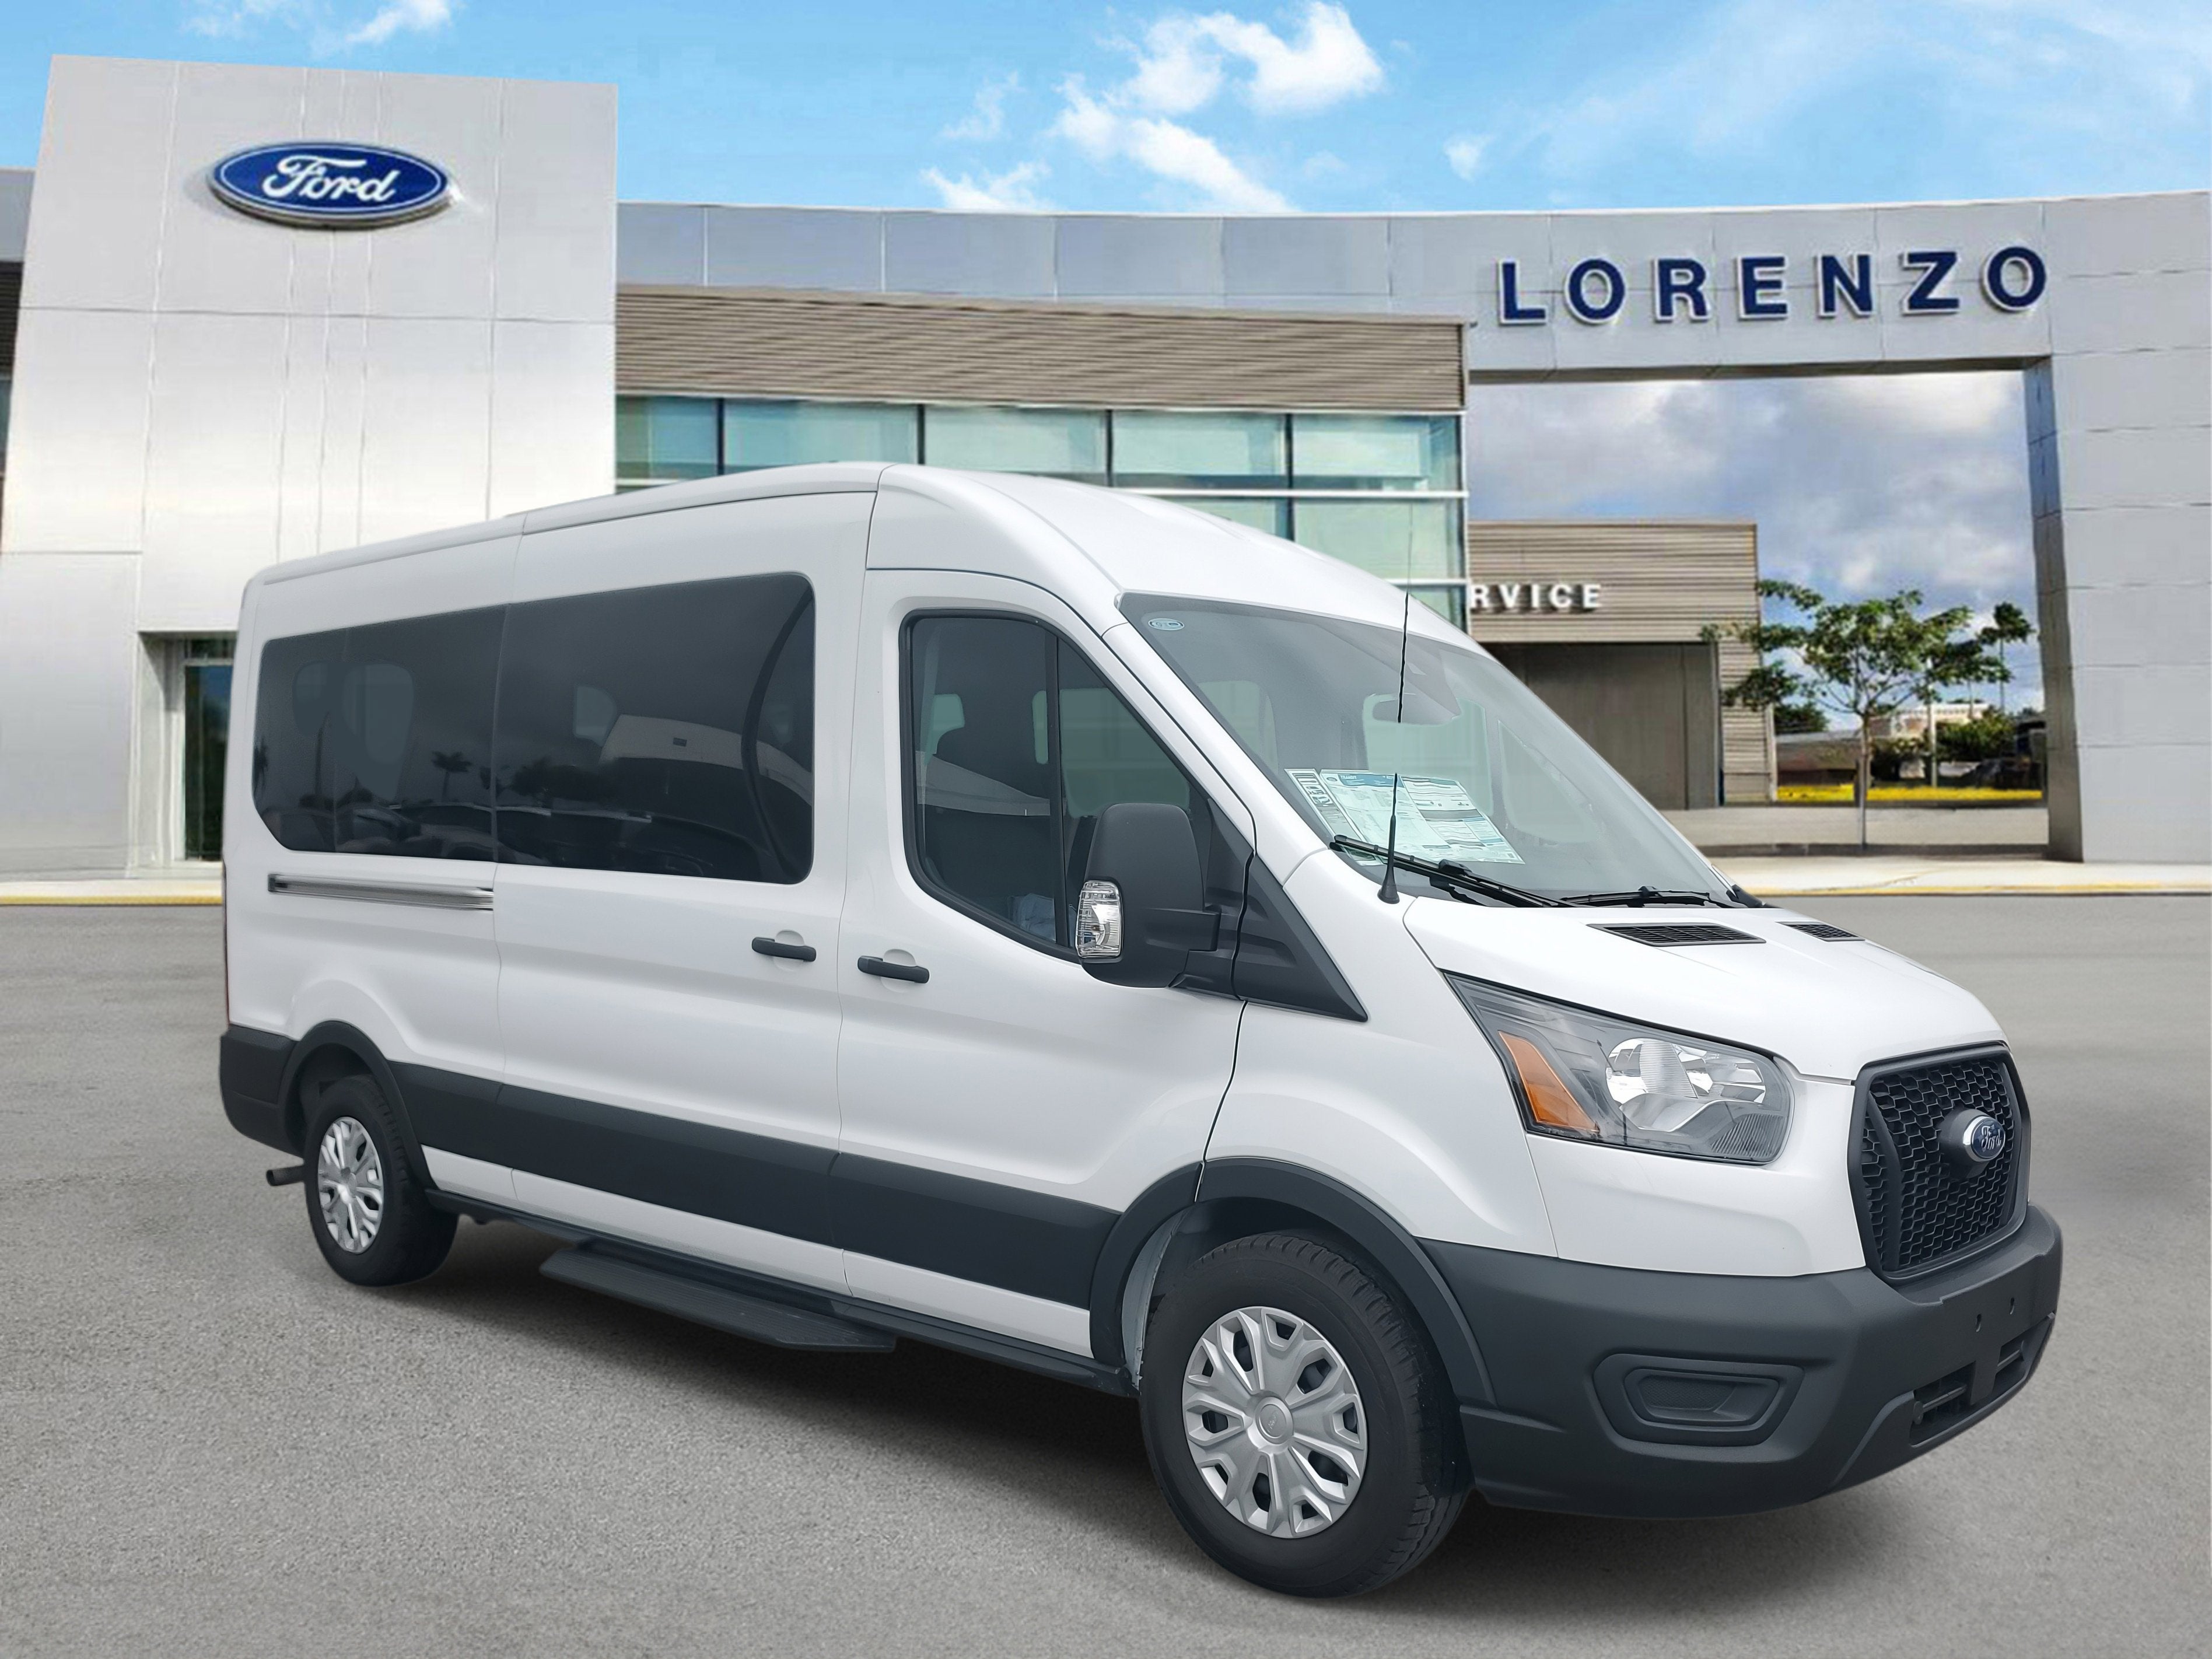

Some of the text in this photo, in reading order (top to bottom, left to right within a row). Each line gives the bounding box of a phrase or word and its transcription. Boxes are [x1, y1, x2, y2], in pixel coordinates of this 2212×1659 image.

[262, 154, 401, 202] Ford
[1499, 246, 2047, 325] LORENZO
[1981, 1125, 2002, 1152] Ford
